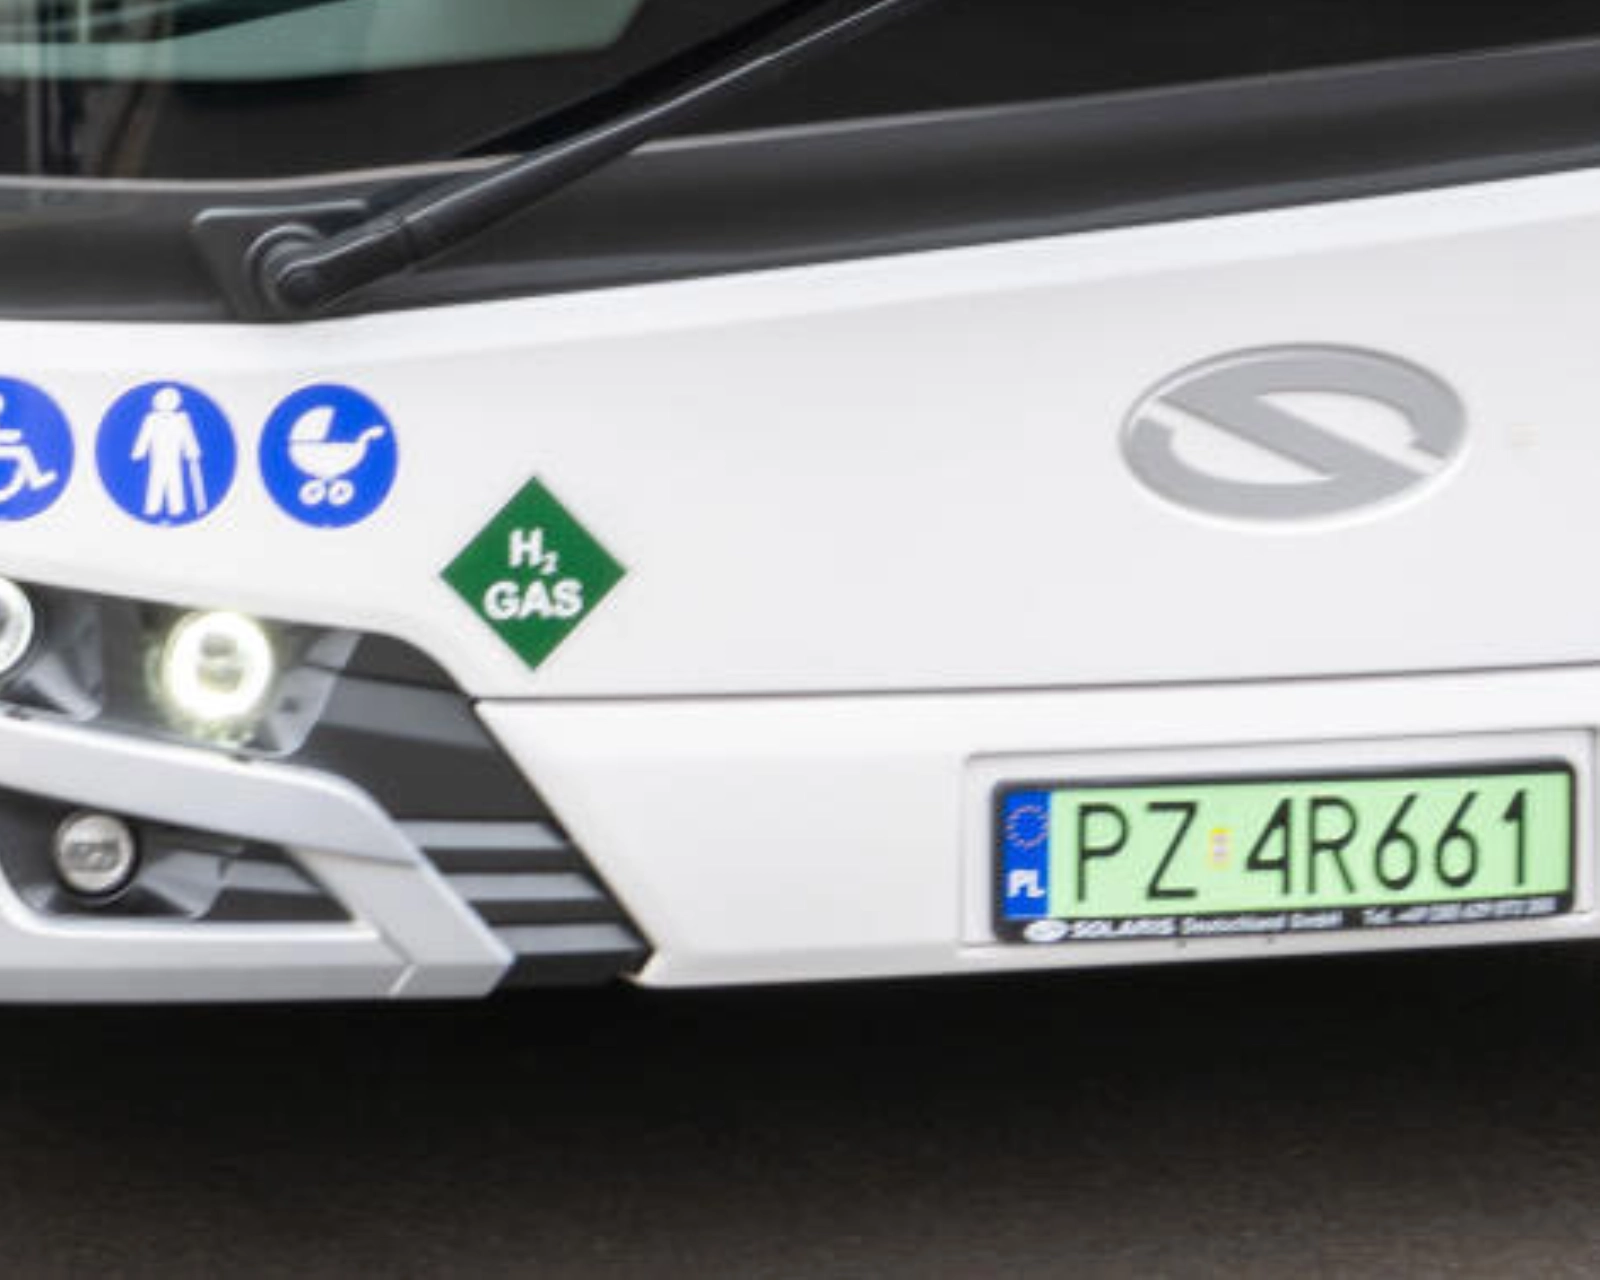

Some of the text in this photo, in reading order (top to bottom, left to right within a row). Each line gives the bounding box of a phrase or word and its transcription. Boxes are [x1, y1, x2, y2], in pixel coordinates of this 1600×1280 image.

[483, 578, 584, 620] GAS
[1075, 789, 1529, 903] PZ 4R661
[1006, 870, 1046, 899] PL
